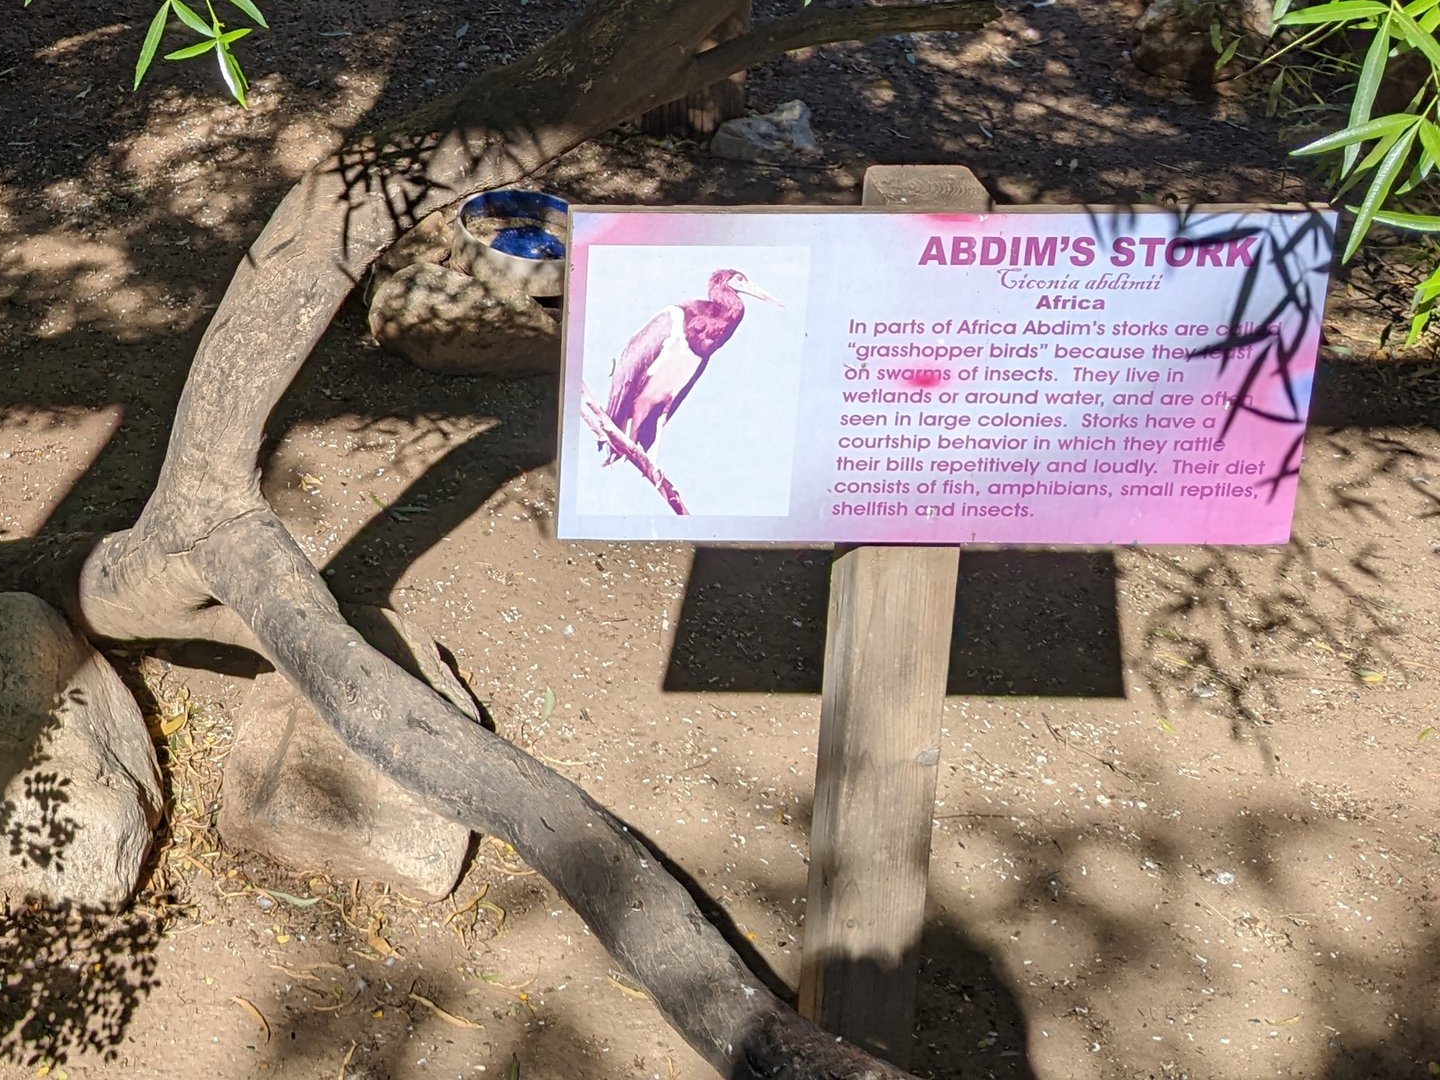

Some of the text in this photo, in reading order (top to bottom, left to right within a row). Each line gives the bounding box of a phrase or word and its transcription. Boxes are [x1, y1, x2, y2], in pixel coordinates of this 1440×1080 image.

[1110, 236, 1258, 268] STORK
[996, 267, 1164, 291] Ciconia abdimii
[1035, 294, 1106, 310] Africa
[849, 318, 867, 335] In
[873, 319, 925, 338] parts
[931, 319, 953, 335] of
[956, 319, 1017, 335] Africa
[1111, 320, 1169, 336] storks
[1174, 324, 1209, 337] are
[1054, 343, 1145, 360] because
[1151, 344, 1198, 363] they
[844, 365, 1184, 385] on swarms of insects. They live in
[842, 388, 932, 404] wetlands
[938, 391, 960, 404] or
[964, 389, 1039, 405] around
[1044, 390, 1105, 408] water,
[1112, 390, 1155, 406] and
[1159, 393, 1195, 406] are
[839, 411, 1216, 431] seen in large colonies. Storks have a
[837, 433, 1227, 455] courtship behavior in which they rattle
[835, 456, 1266, 477] their bills repetitively and loudly. Their diet
[833, 479, 1260, 500] consists of fish, amphibians, small reptiles,
[831, 500, 1034, 518] shellfish and insects.
